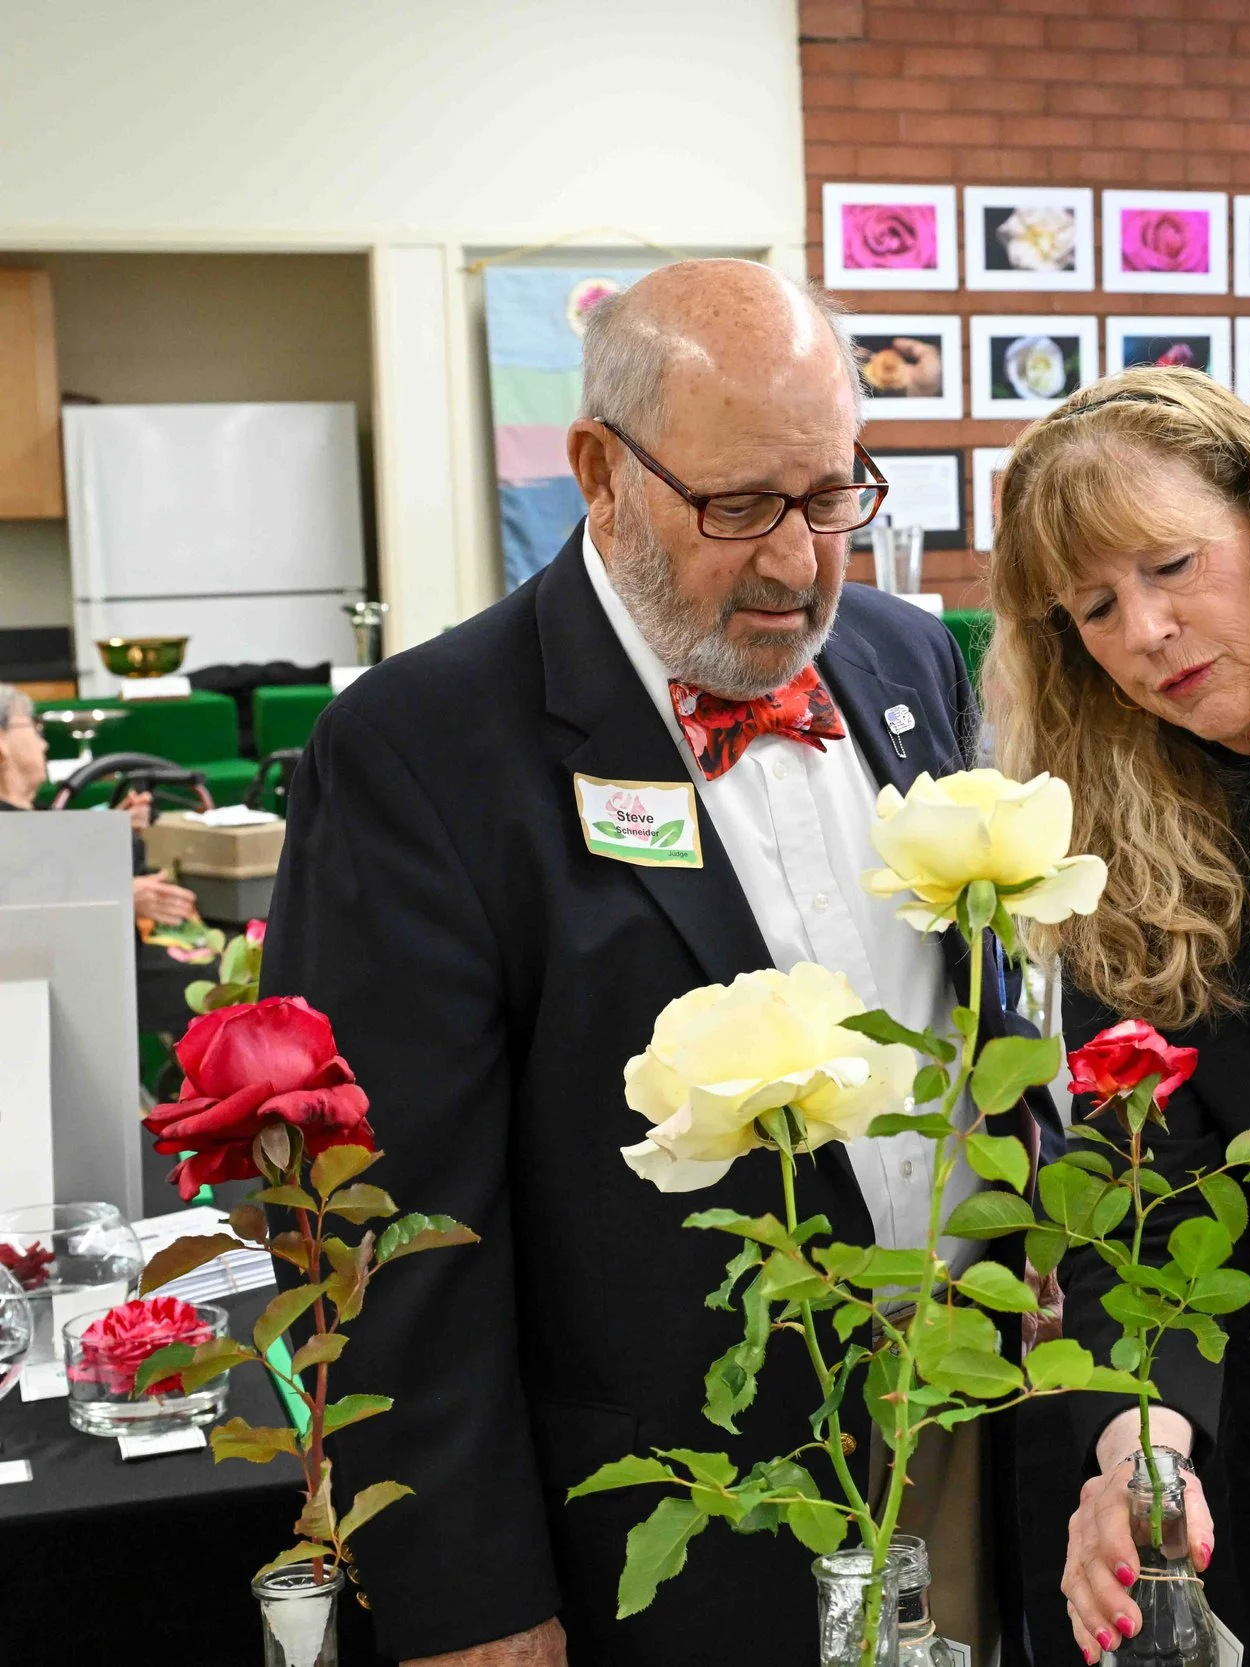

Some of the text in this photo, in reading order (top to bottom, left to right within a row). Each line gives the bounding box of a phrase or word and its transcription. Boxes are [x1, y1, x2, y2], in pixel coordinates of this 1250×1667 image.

[616, 810, 654, 823] Steve
[615, 826, 660, 837] Schneider
[668, 850, 689, 858] Judge
